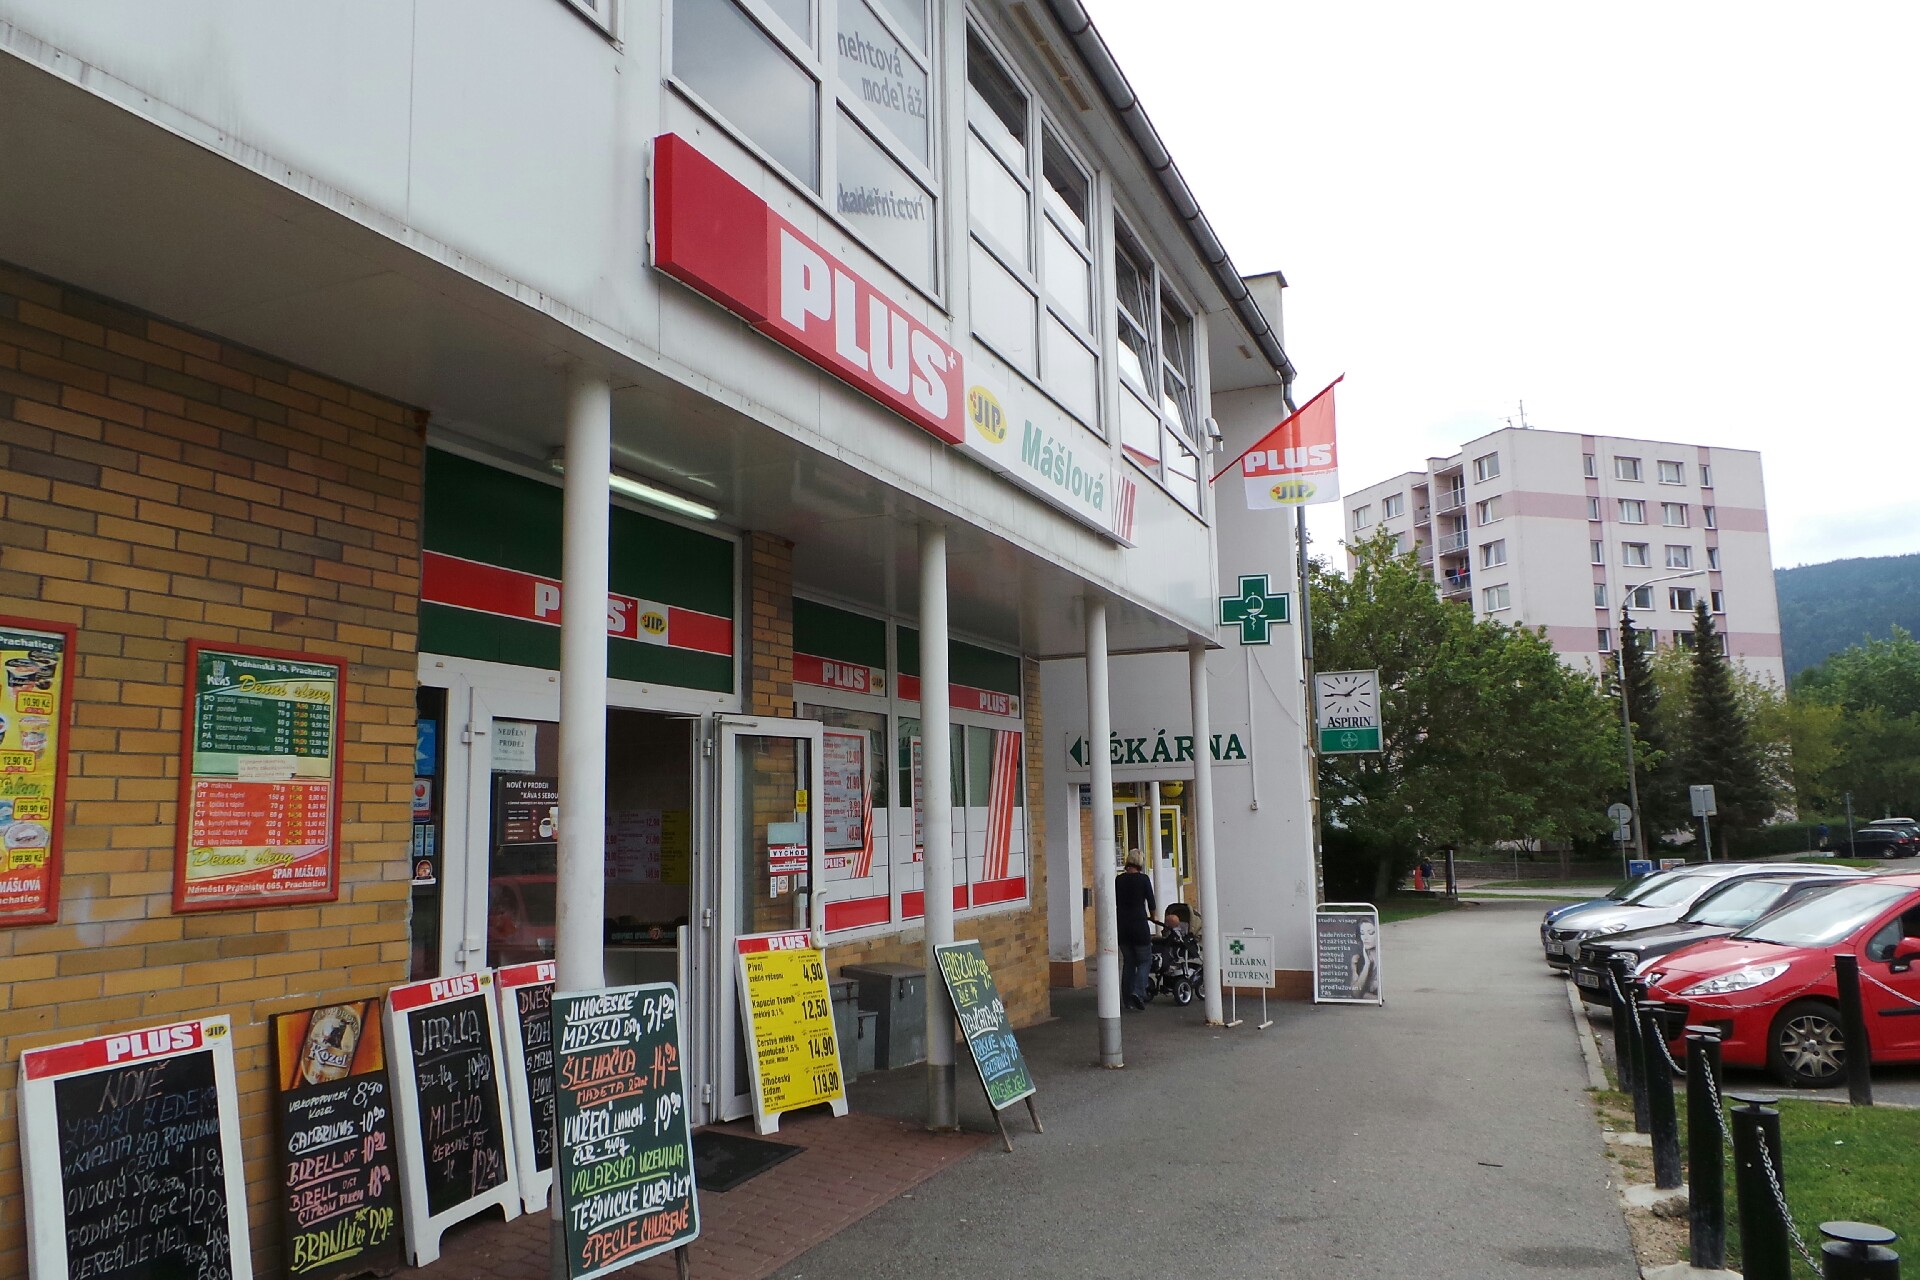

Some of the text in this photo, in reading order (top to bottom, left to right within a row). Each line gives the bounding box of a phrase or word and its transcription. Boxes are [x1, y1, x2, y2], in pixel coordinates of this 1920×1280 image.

[837, 31, 904, 78] nehtová
[861, 77, 925, 120] modeláž
[781, 227, 1104, 512] PLUS JIP Mášlová
[1244, 443, 1332, 474] PLUS
[1277, 484, 1308, 500] JIP
[534, 581, 626, 633] PS
[207, 674, 231, 687] KLAS
[290, 666, 331, 678] Prachatice
[822, 661, 866, 690] PLUS
[239, 674, 331, 704] Denní slevy
[979, 693, 1007, 713] PLUS
[1327, 715, 1371, 728] ASPIRIN
[1084, 728, 1247, 766] ÉKÁRNA
[192, 847, 296, 867] Denní slevy
[824, 858, 845, 869] PLUS
[272, 864, 327, 879] SPAR MÁŠLOVÁ
[187, 883, 224, 894] Náměstí
[284, 879, 326, 890] Prachatice
[768, 934, 807, 951] PLUS
[802, 962, 824, 984] 4,90
[430, 974, 476, 1002] PLUS
[564, 989, 640, 1024] JIHOČESKÉ
[801, 998, 828, 1021] 12,50
[105, 1024, 226, 1064] PLUS JIP
[414, 1009, 482, 1057] JABLKA
[307, 1043, 348, 1067] Kozel
[807, 1036, 836, 1060] 14,90
[560, 1046, 637, 1090] ŠLEHAČKA
[576, 1079, 626, 1106] MADETA
[812, 1071, 840, 1096] 119,90
[428, 1089, 484, 1142] MLÉKO
[286, 1149, 345, 1187] BIRELL
[570, 1146, 638, 1197] VOLARSKÁ
[66, 1167, 128, 1217] OVOCNÝ
